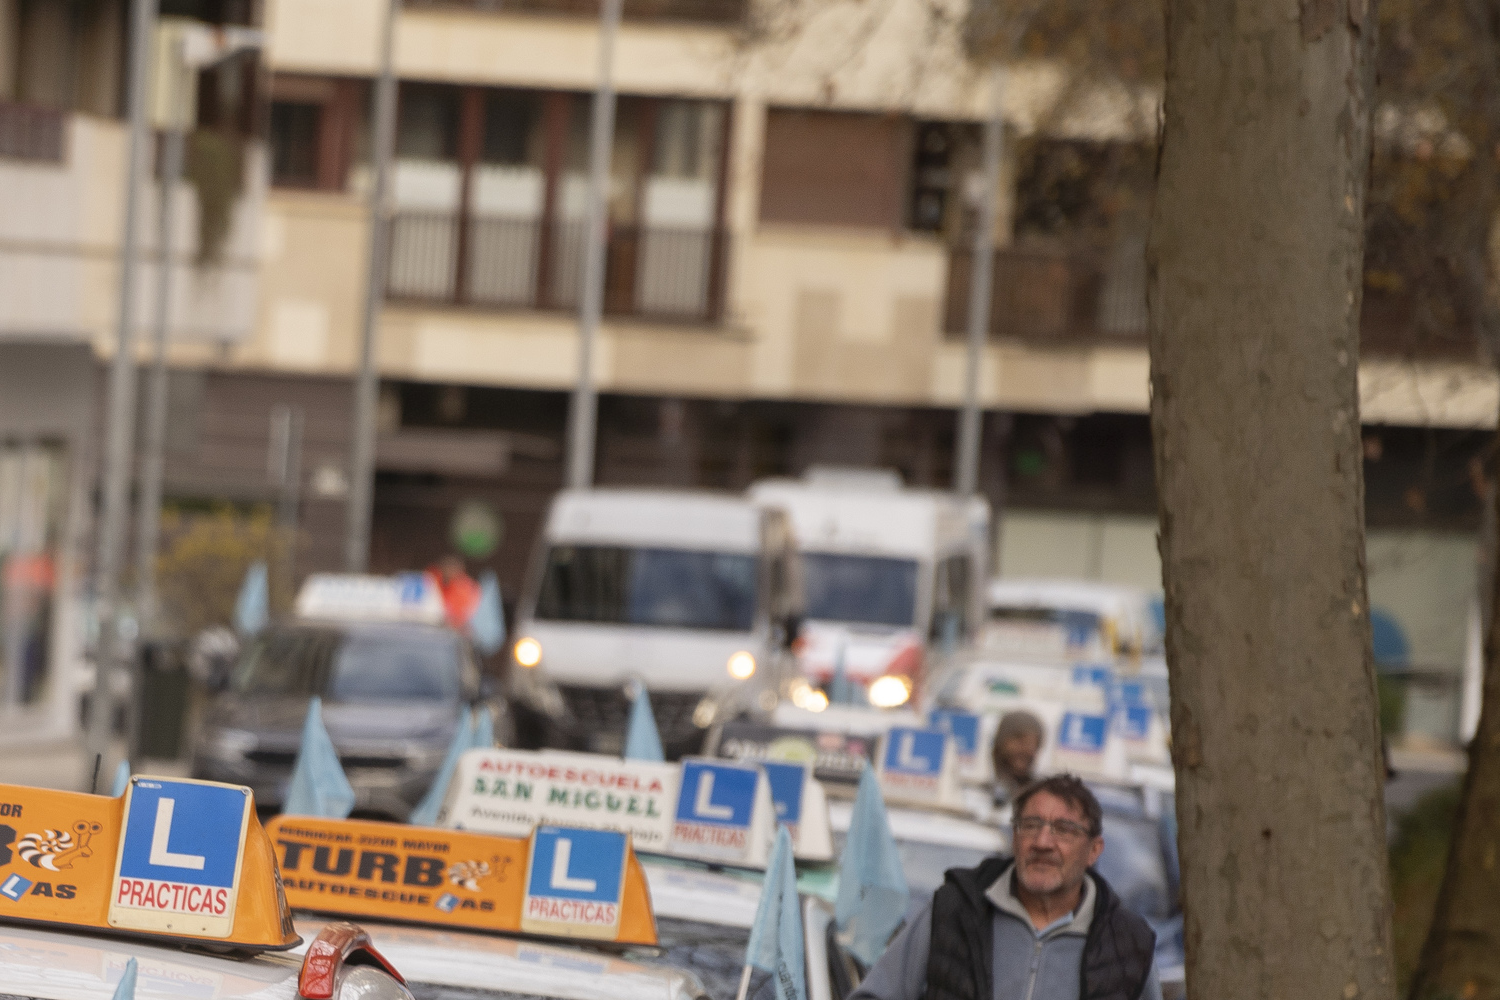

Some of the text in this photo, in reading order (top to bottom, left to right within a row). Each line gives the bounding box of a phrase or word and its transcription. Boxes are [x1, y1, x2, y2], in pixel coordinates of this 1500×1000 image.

[479, 757, 664, 793] AUTOESCUELA
[695, 770, 735, 820] L
[473, 776, 662, 819] SAN MIGUEL
[149, 797, 206, 870] L
[551, 838, 597, 893] L
[117, 878, 228, 915] PRACTICAS
[529, 896, 616, 925] PRACTICAS
